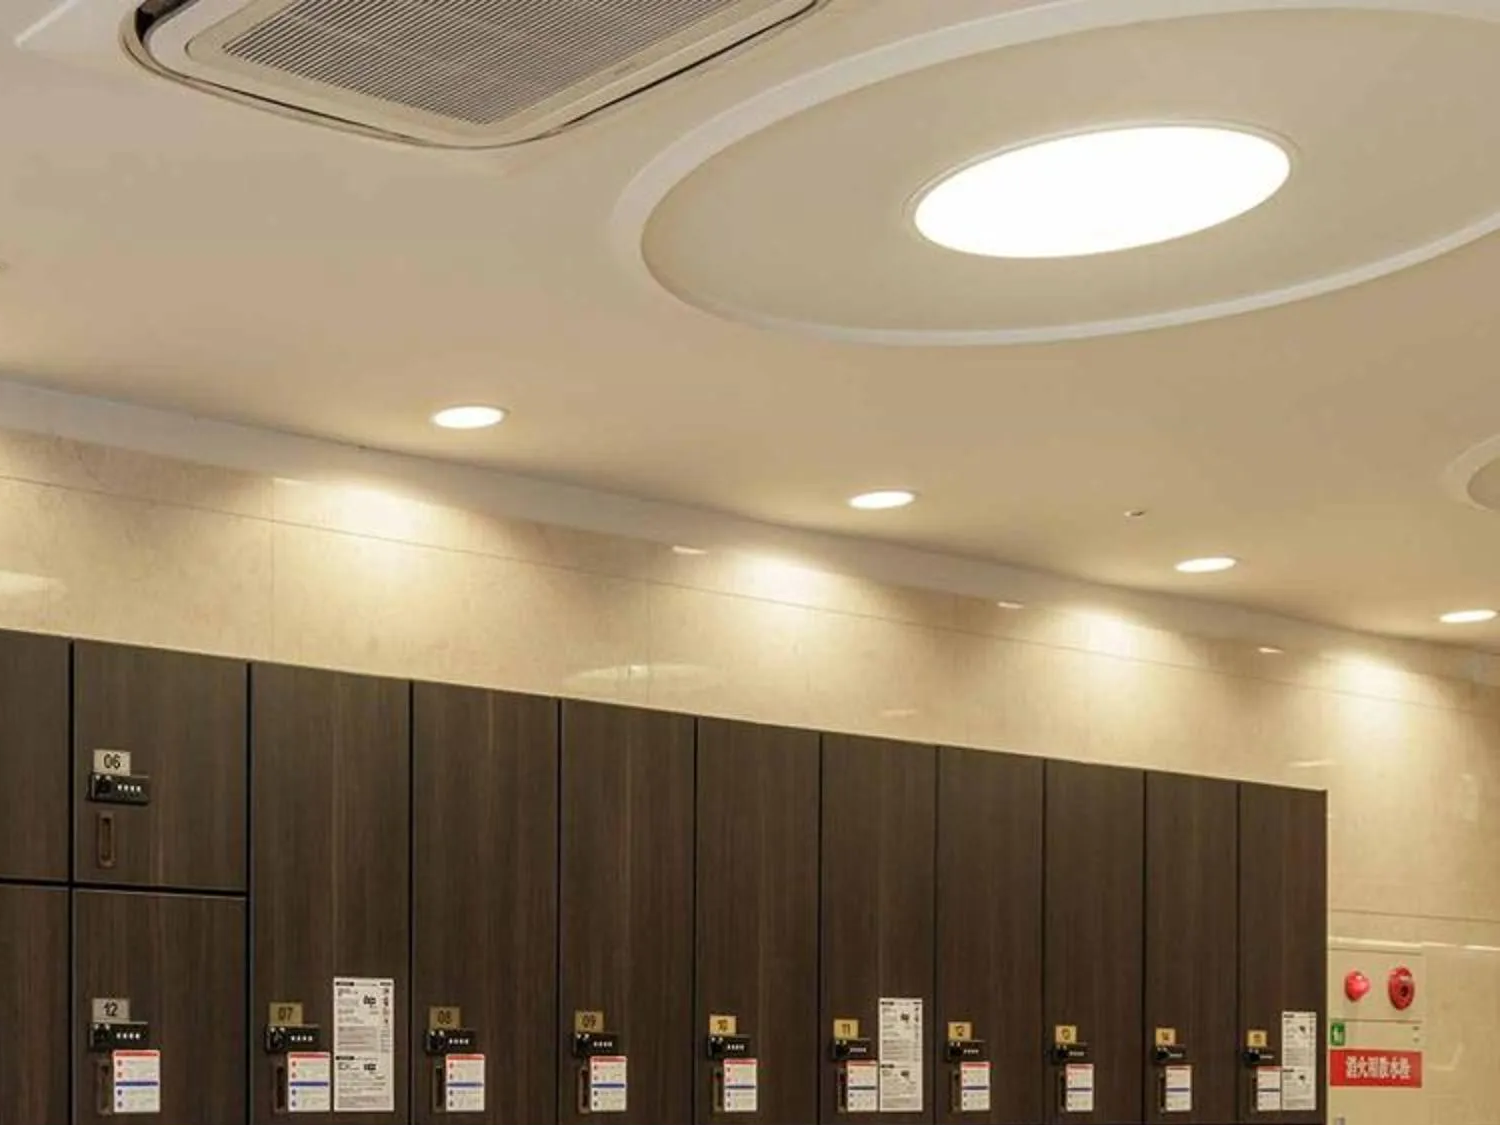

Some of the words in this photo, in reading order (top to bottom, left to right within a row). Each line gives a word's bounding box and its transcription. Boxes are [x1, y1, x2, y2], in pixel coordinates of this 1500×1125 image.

[103, 754, 120, 769] 06
[104, 1002, 118, 1016] 12
[278, 1007, 293, 1021] 07
